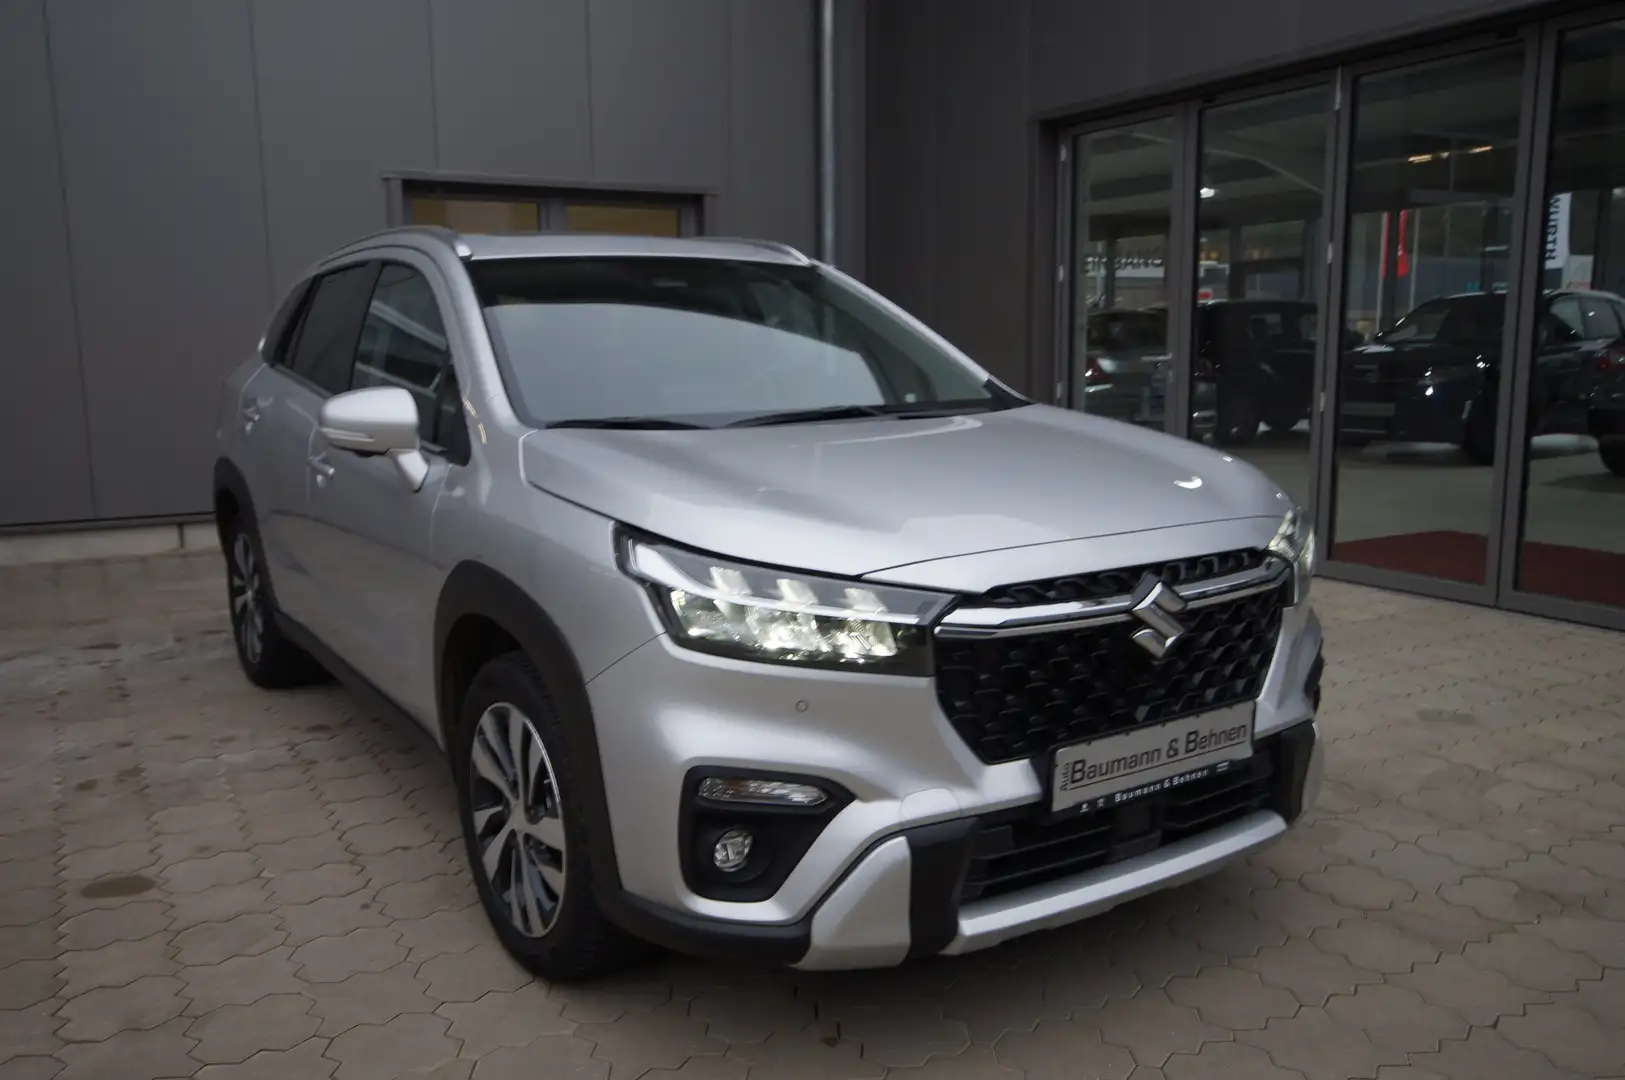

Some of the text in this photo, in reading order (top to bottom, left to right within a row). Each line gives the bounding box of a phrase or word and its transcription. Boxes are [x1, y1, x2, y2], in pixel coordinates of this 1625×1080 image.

[1070, 724, 1247, 784] Baumann & Behnen
[1114, 769, 1209, 803] Baumann & Behnen
